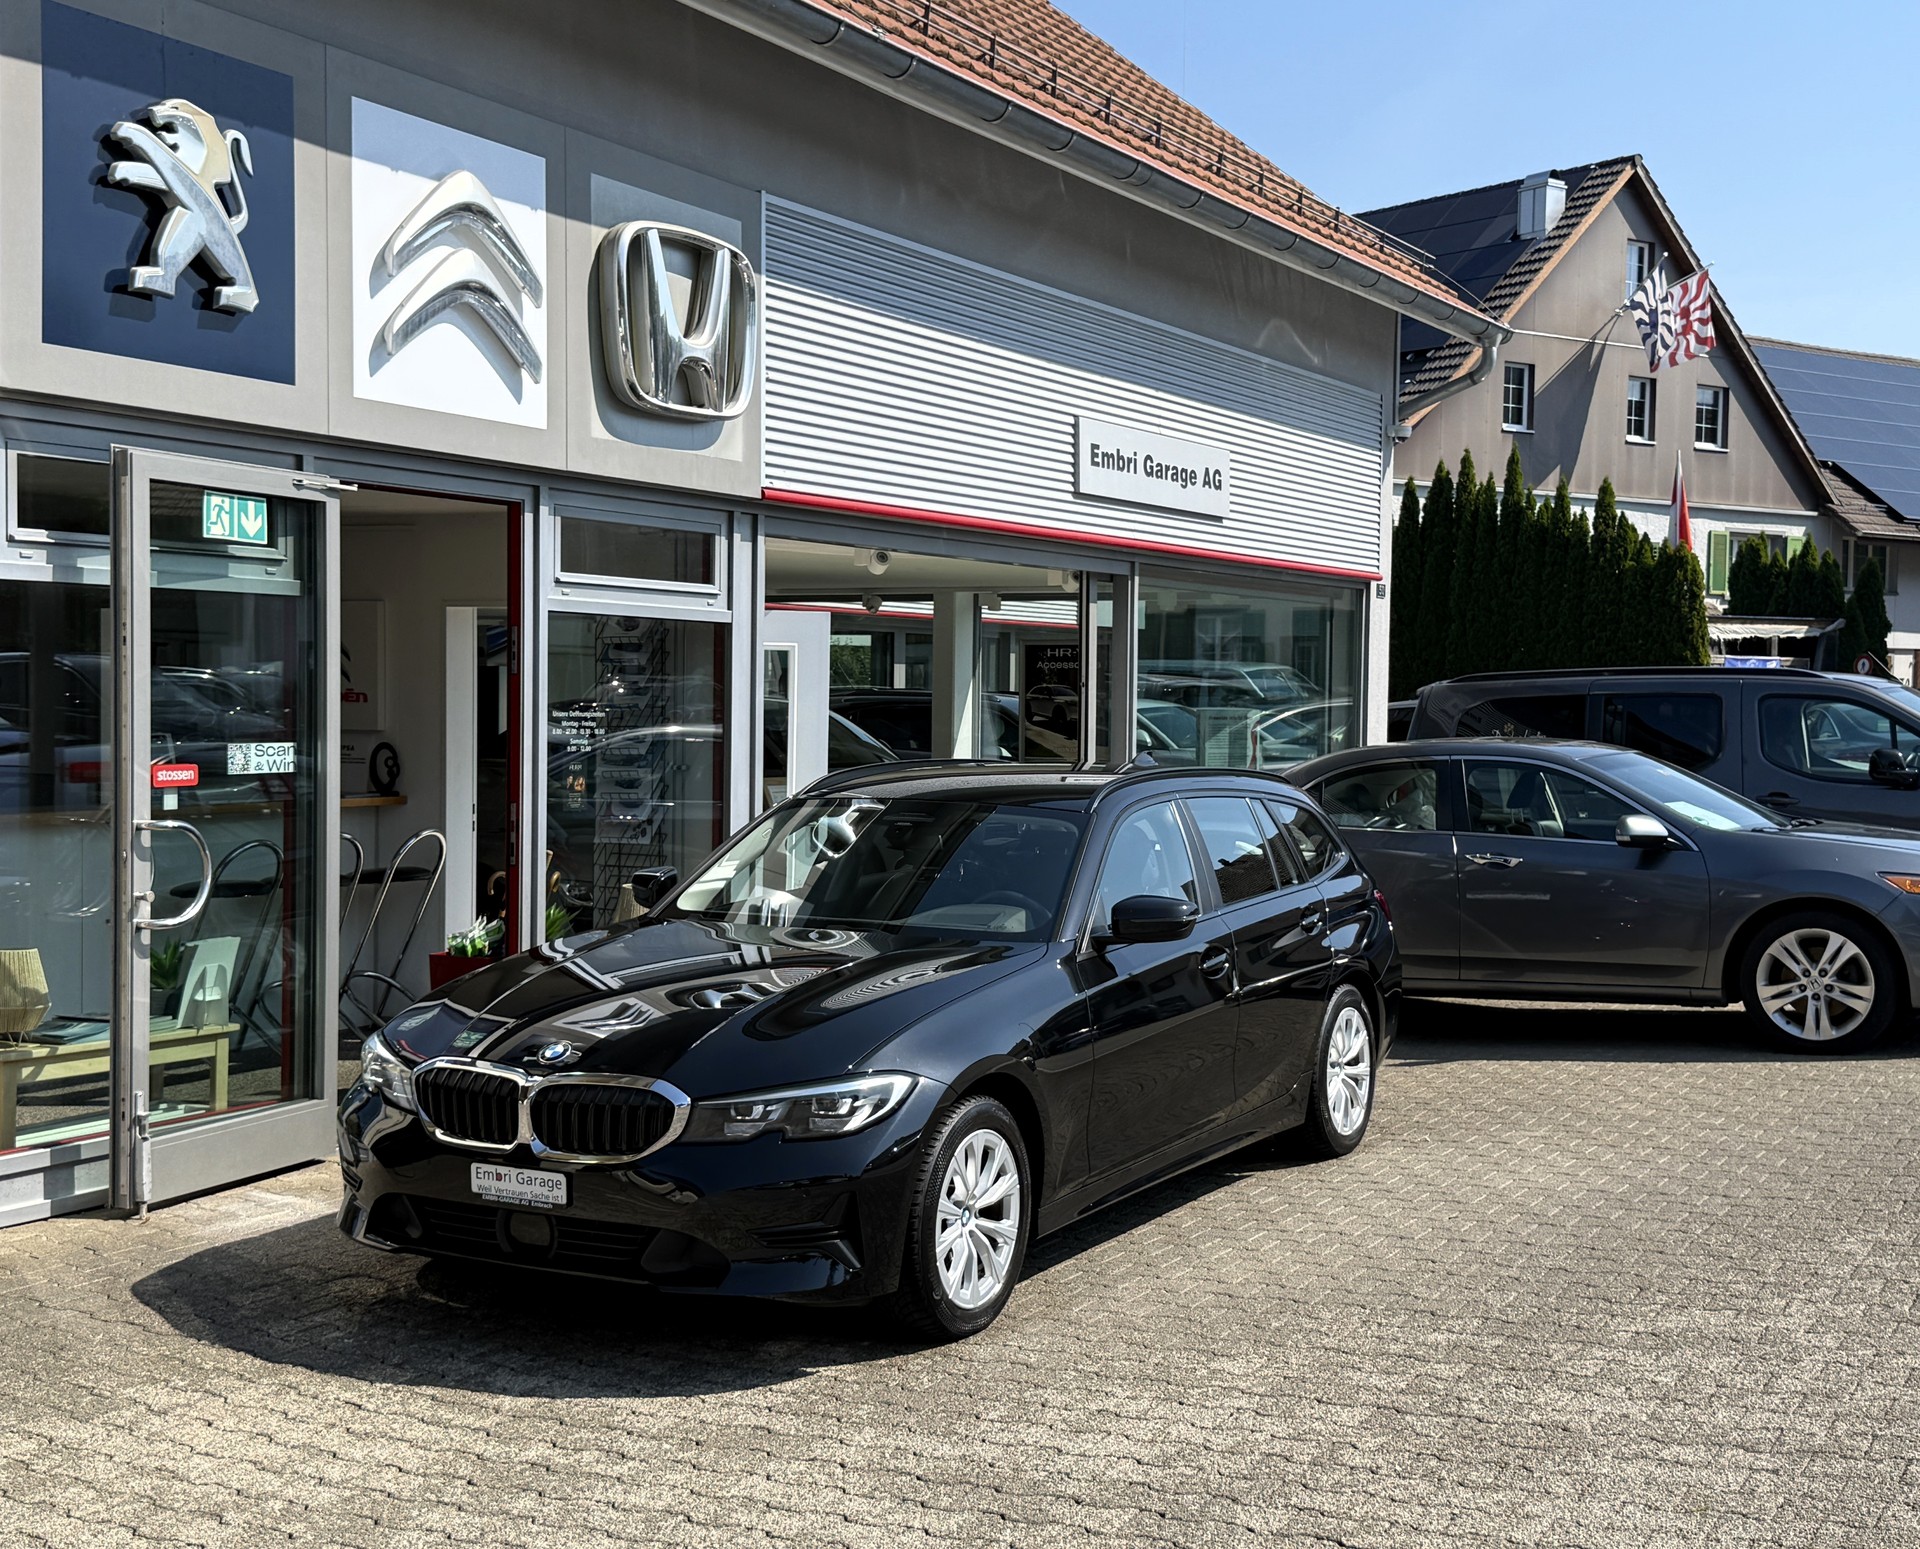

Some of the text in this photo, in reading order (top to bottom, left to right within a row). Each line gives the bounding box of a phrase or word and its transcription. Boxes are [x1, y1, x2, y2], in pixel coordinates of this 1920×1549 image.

[1090, 442, 1223, 491] Embri Garage AG
[1036, 661, 1079, 669] Accesso
[569, 710, 606, 719] Oeffnungszeiten
[561, 720, 579, 728] Montag
[581, 720, 597, 728] Freitag
[254, 744, 296, 757] Scan
[254, 757, 296, 772] & Win
[157, 769, 194, 781] stossen
[475, 1167, 562, 1192] Embri Garage
[477, 1184, 492, 1193] Weil
[493, 1186, 529, 1198] Vertrauen
[530, 1190, 551, 1201] Sache
[551, 1193, 560, 1202] ist
[531, 1200, 553, 1209] Embrach
